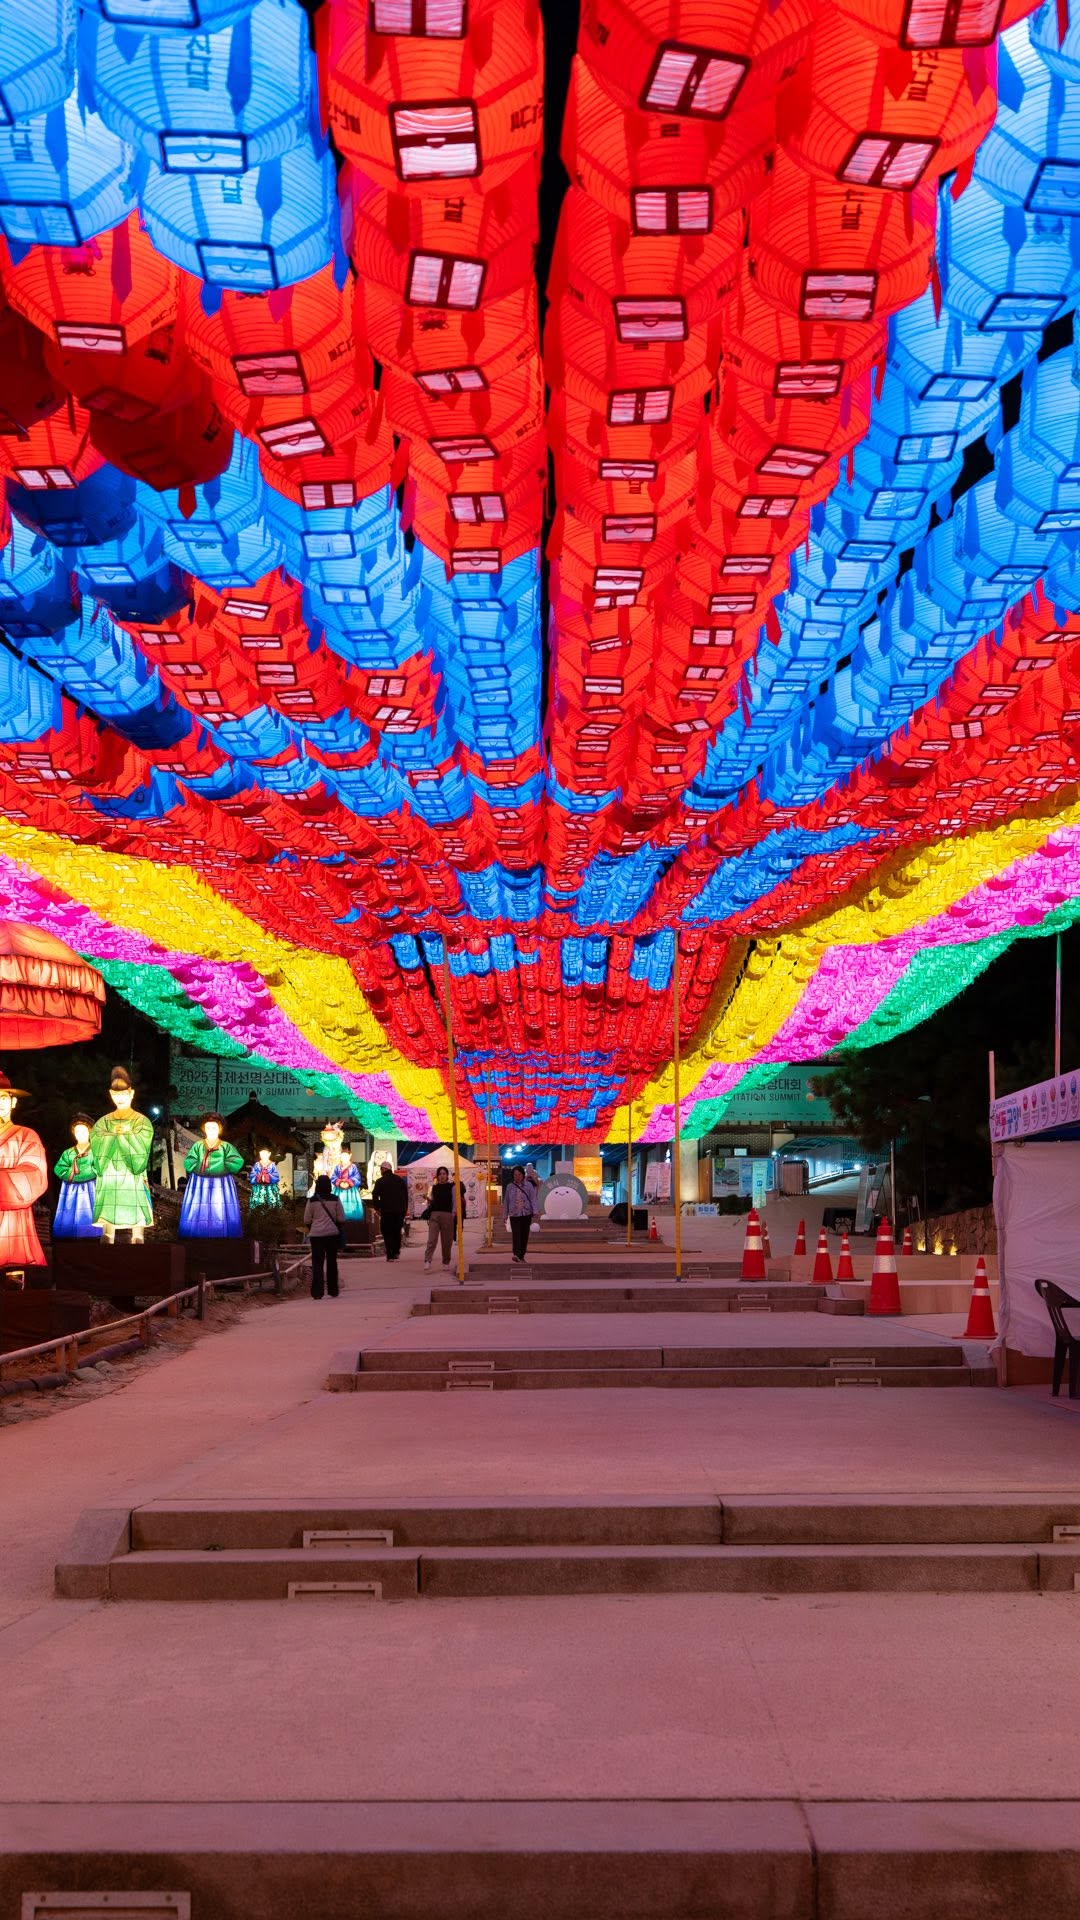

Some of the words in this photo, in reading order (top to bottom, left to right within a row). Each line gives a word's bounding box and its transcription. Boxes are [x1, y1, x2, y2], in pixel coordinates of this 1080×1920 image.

[205, 1086, 262, 1096] MDITATIN
[265, 1087, 301, 1096] SUMMIT
[769, 1093, 801, 1102] SUMMIT
